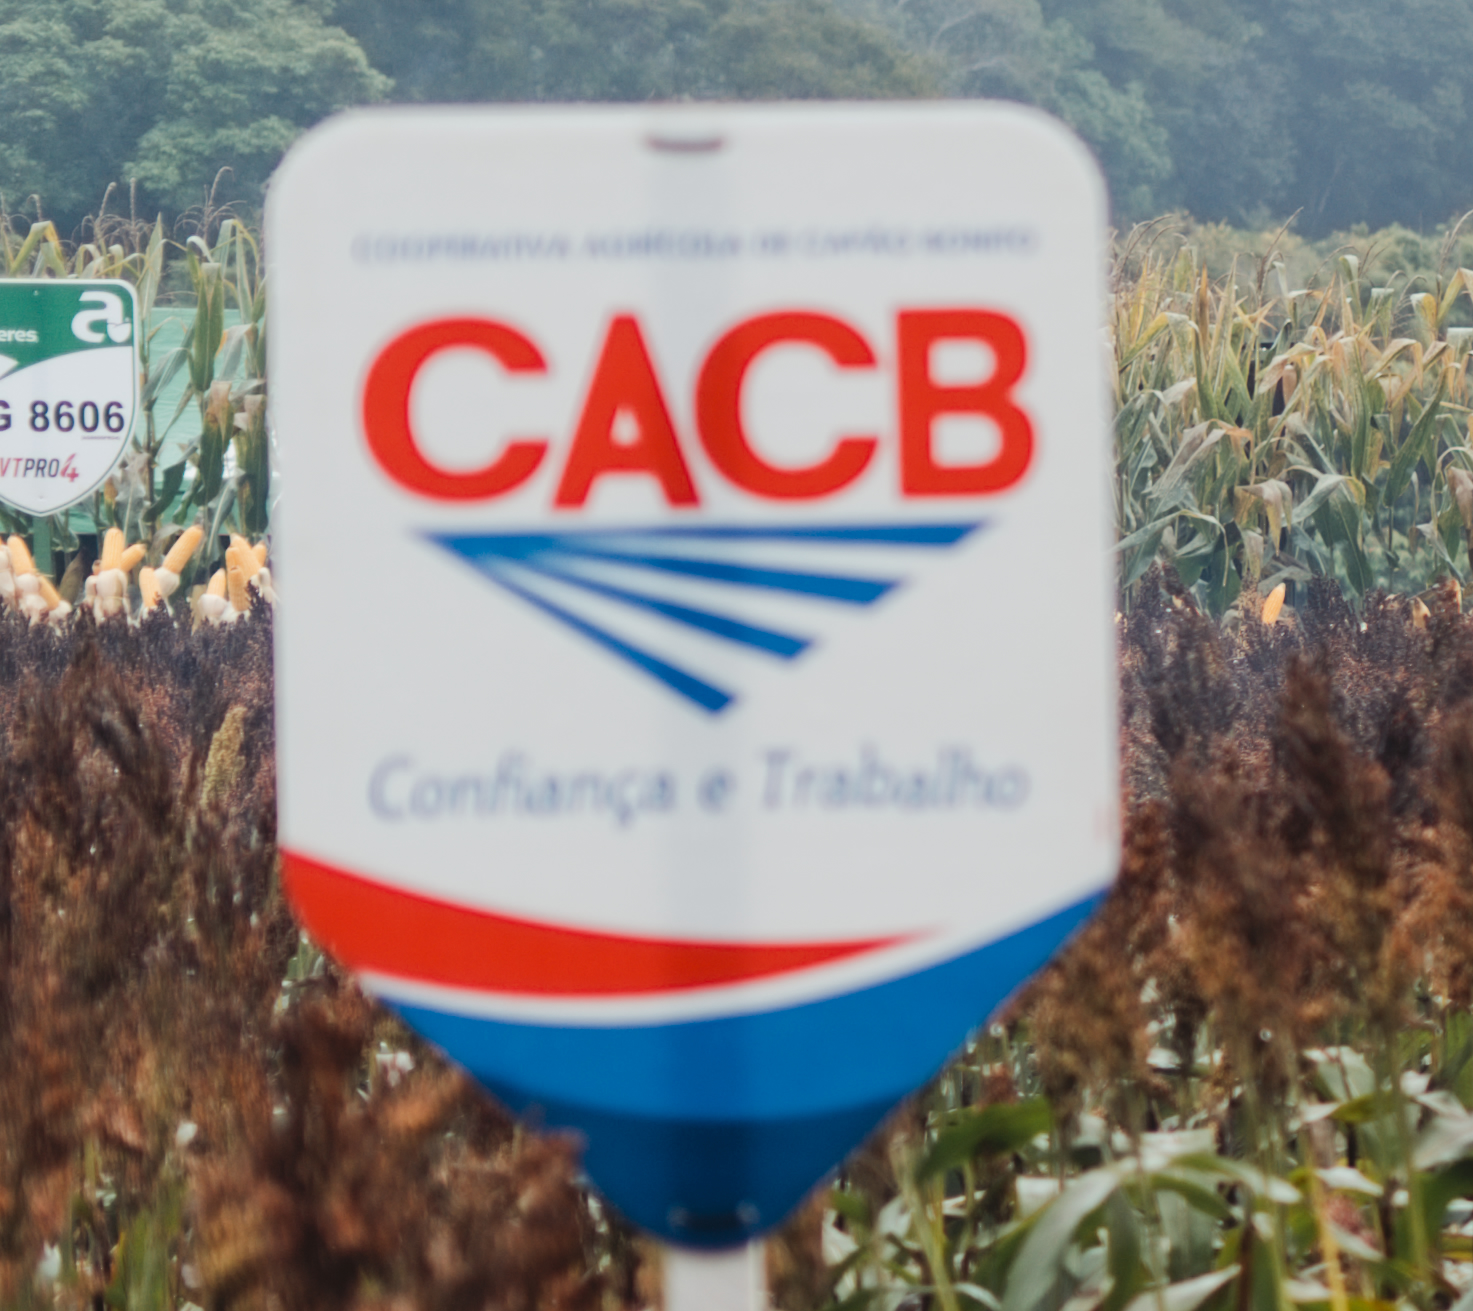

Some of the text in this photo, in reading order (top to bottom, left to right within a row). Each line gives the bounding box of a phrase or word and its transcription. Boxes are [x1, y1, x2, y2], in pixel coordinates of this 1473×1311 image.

[30, 400, 124, 432] 8606
[359, 308, 1039, 509] CACB
[370, 741, 1029, 828] Confiança e Trabalho
